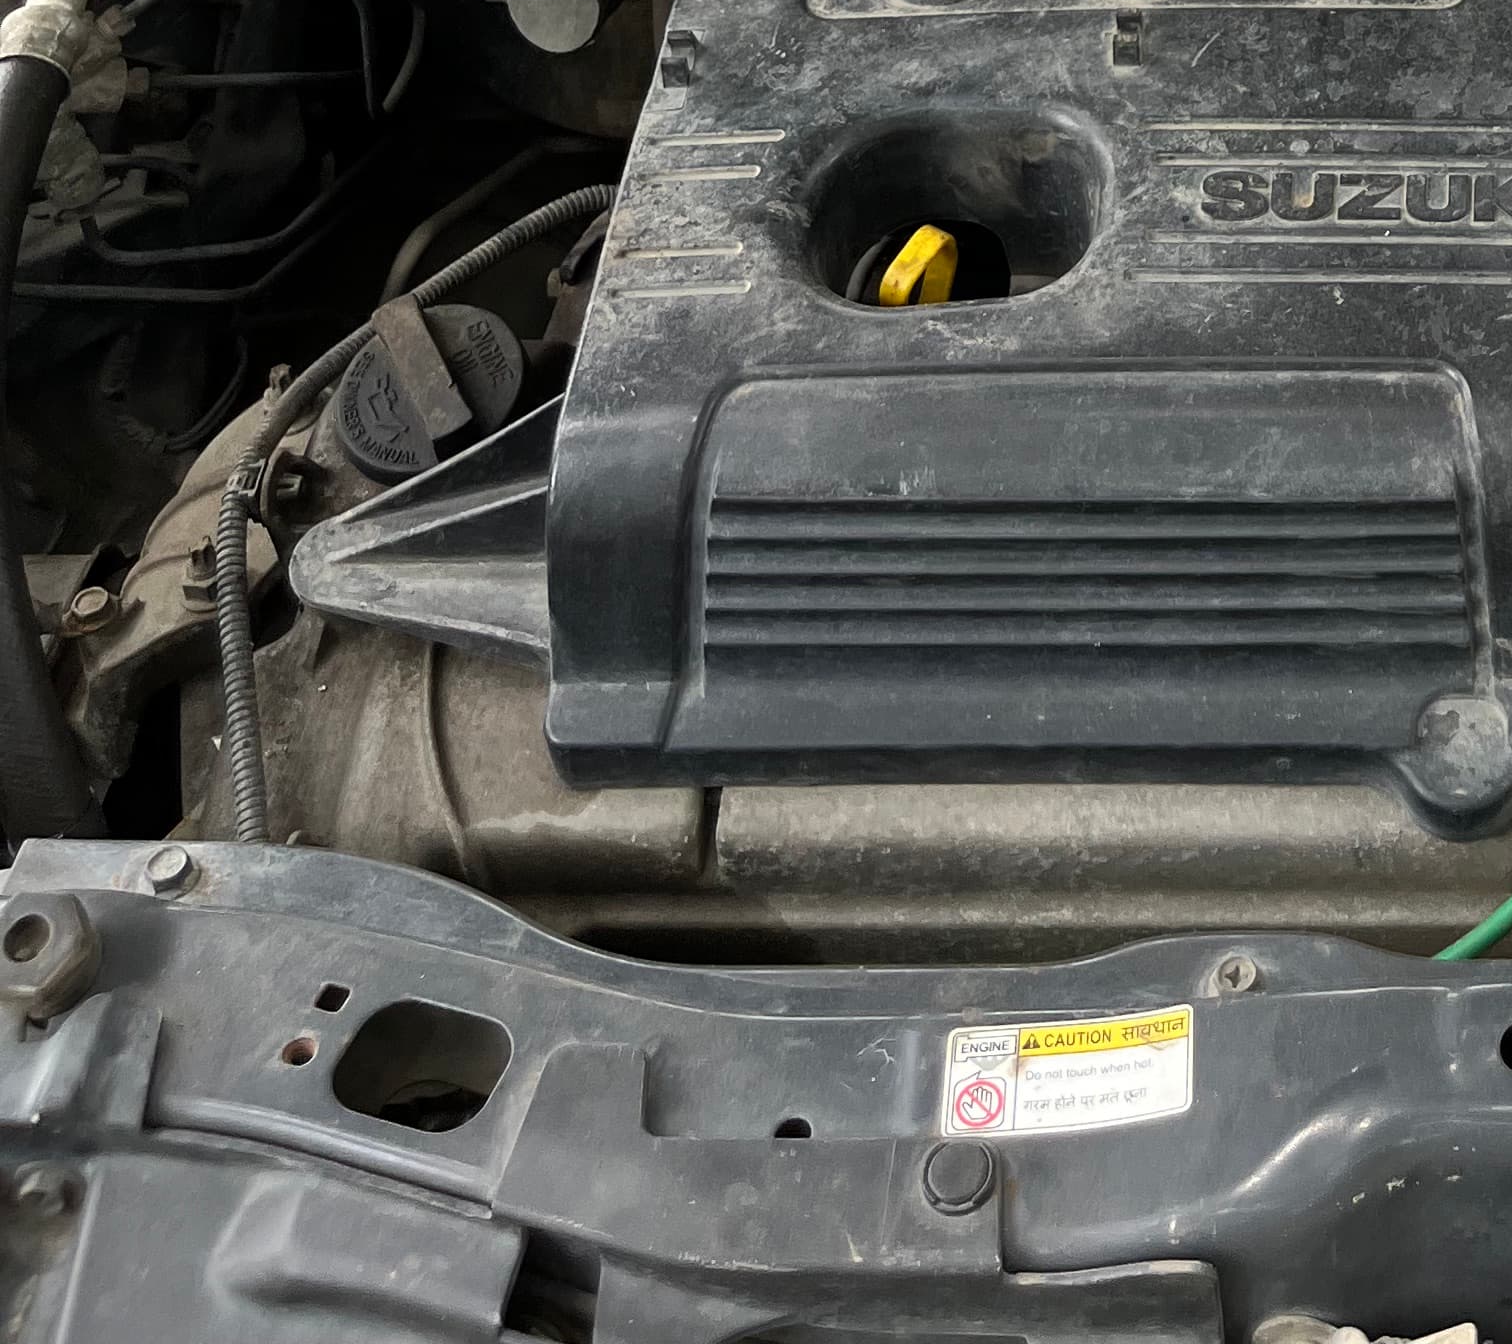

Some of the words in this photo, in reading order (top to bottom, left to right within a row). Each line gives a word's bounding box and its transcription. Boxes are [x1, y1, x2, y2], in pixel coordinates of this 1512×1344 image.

[467, 319, 514, 389] ENGINE
[360, 436, 420, 466] MANUAL
[1043, 1028, 1112, 1049] CAUTION
[1120, 1016, 1186, 1042] सावधान
[960, 1039, 1010, 1055] ENGINE
[1025, 1069, 1042, 1081] Do
[1045, 1069, 1063, 1080] not
[1066, 1065, 1097, 1079] touch
[1100, 1062, 1131, 1075] when
[1024, 1098, 1052, 1112] गरम
[1054, 1093, 1076, 1111] होने
[1080, 1095, 1096, 1110] पर
